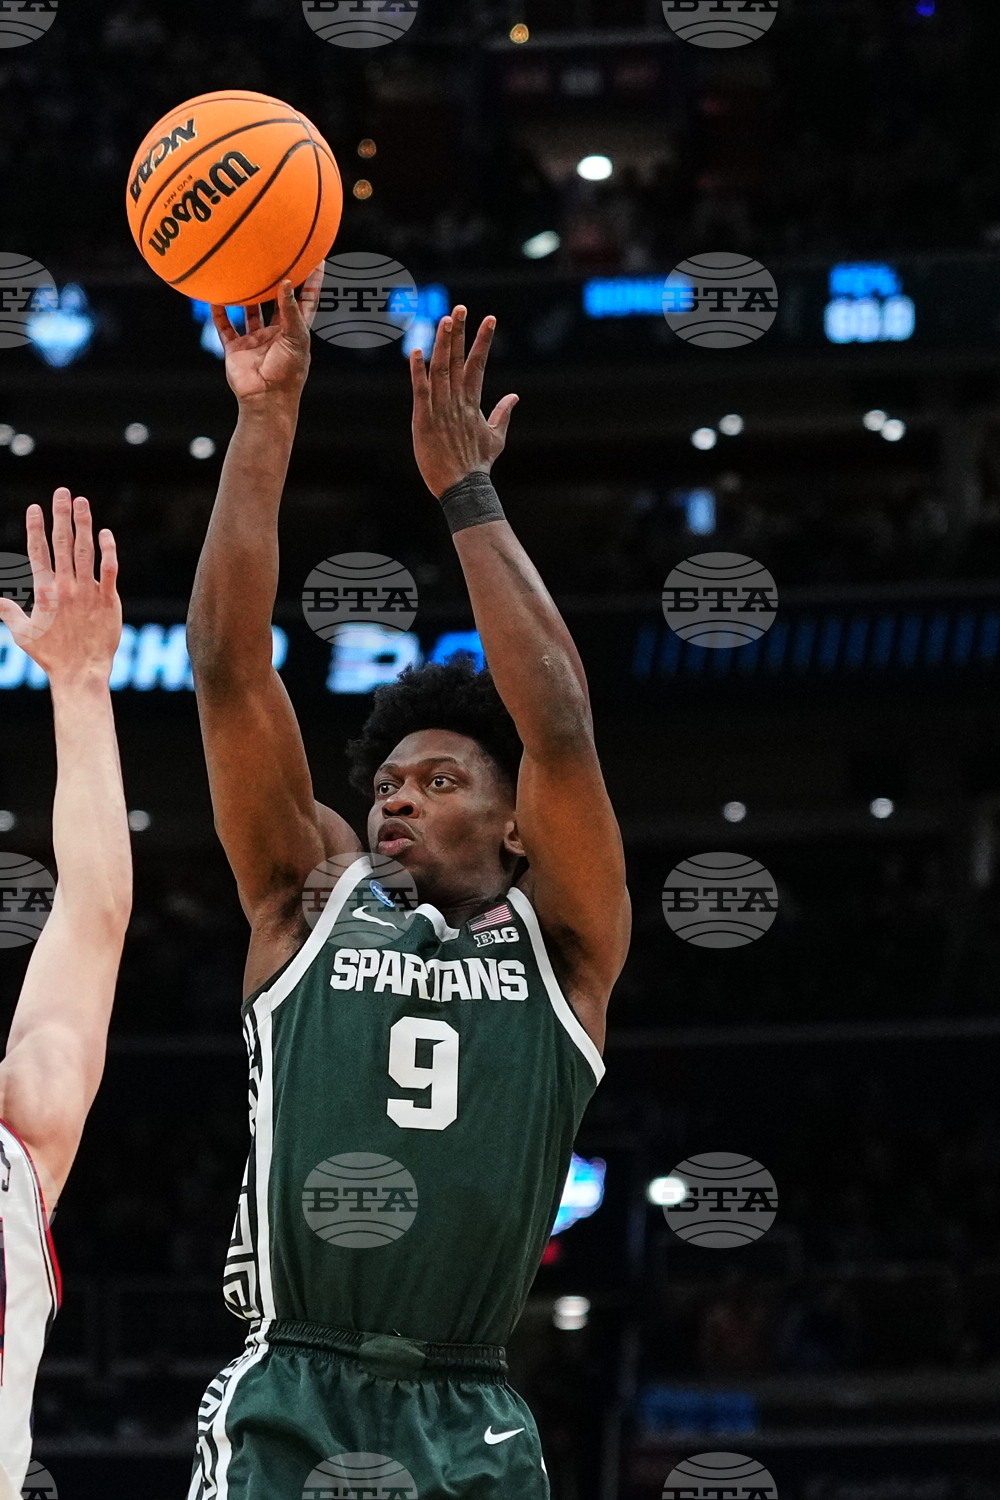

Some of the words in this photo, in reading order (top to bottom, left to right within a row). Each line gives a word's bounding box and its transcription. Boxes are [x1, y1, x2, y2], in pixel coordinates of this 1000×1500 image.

[130, 118, 197, 204] NCAA
[149, 151, 261, 257] Wilson
[330, 948, 529, 1003] SPARTANS
[386, 1016, 460, 1131] 9
